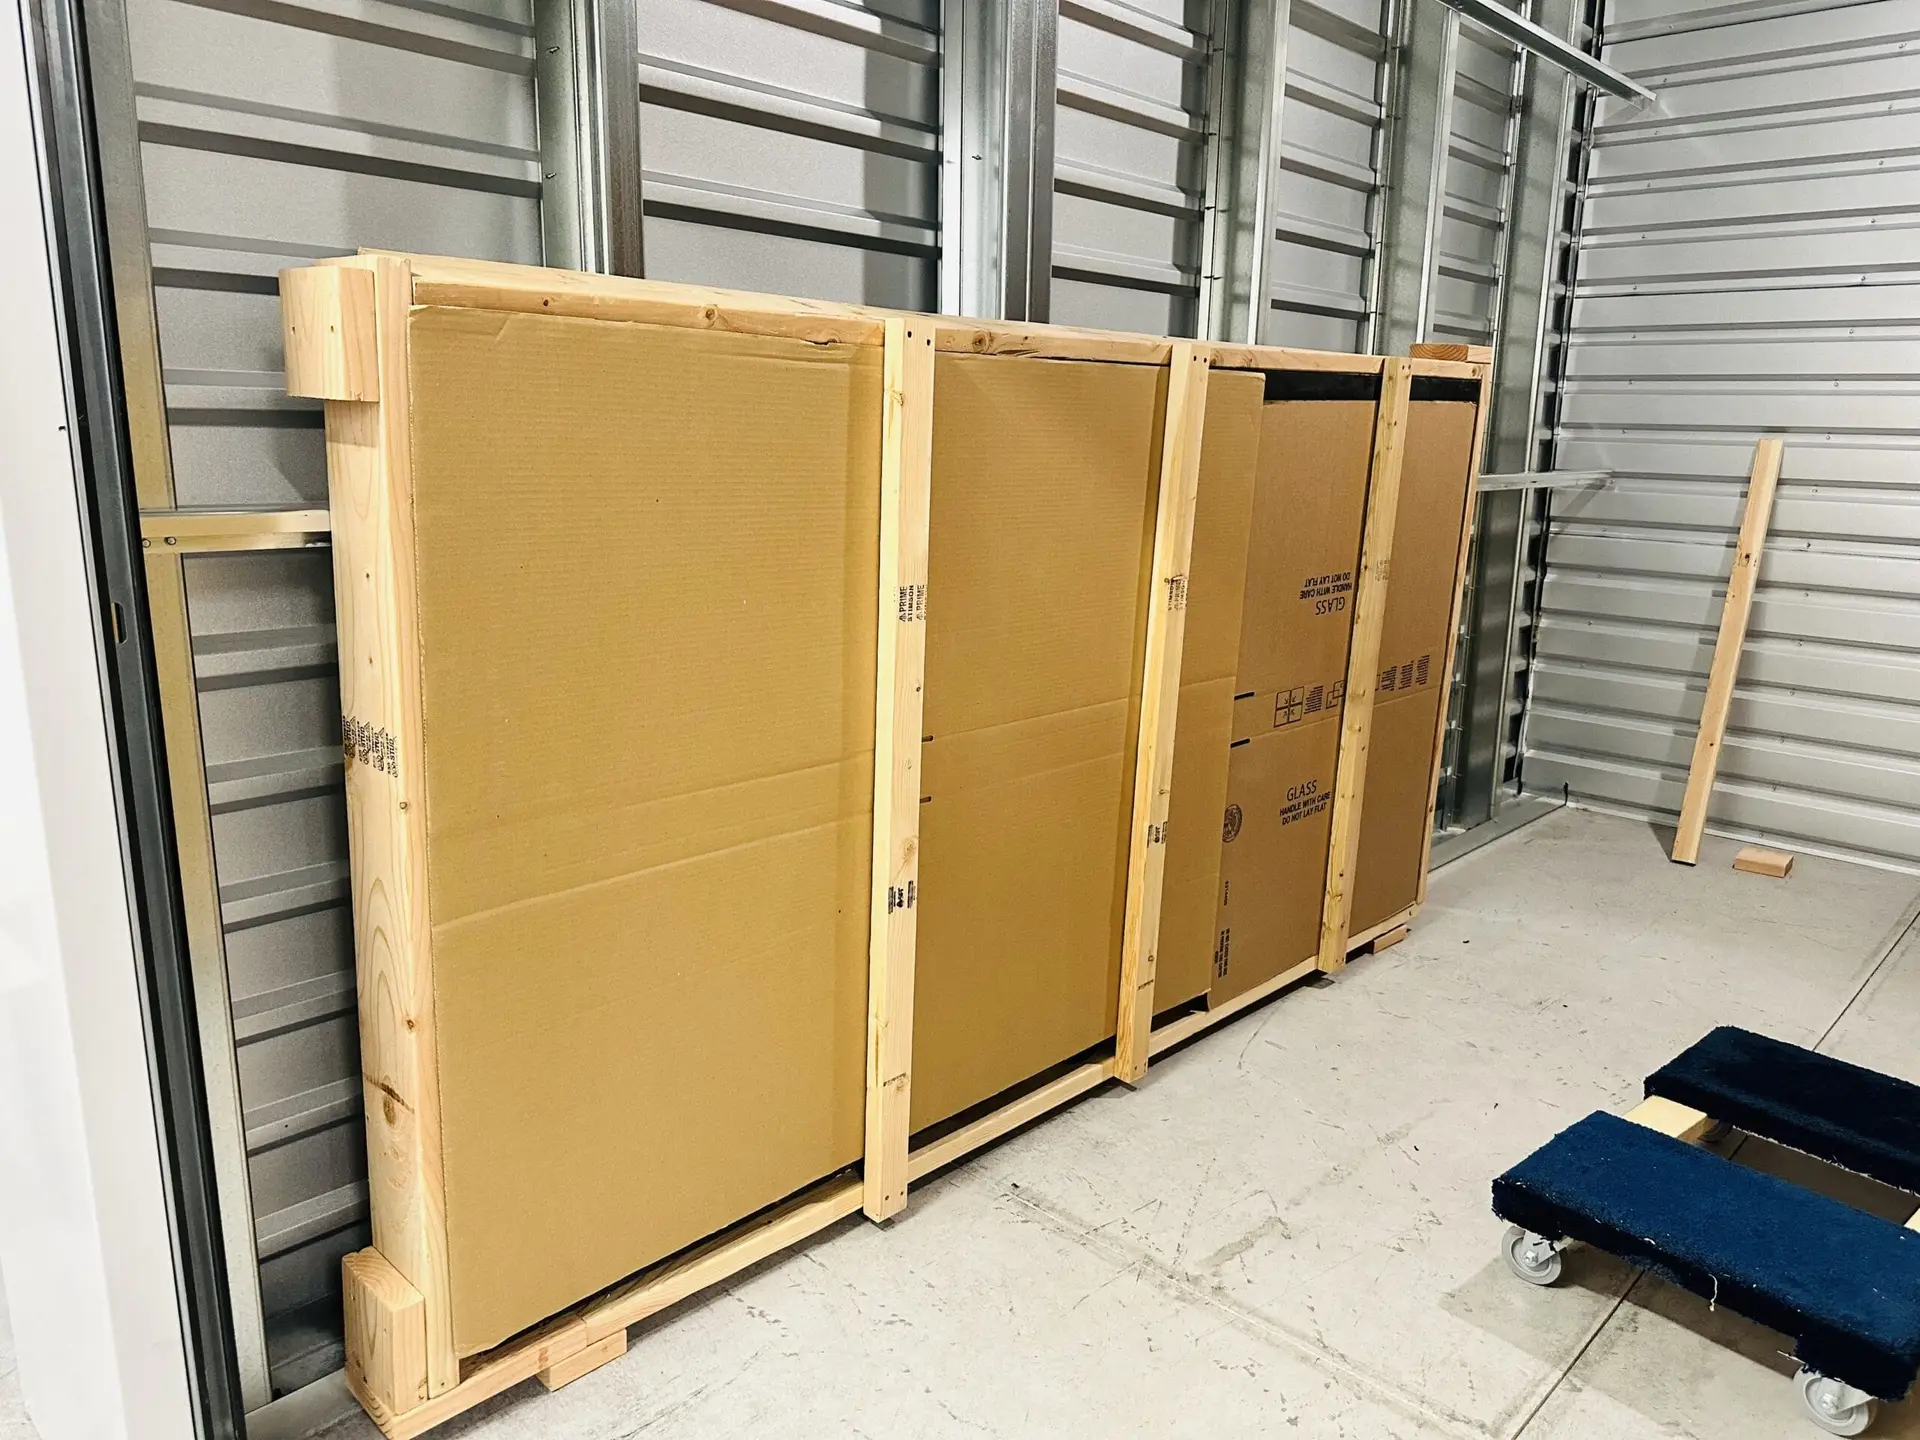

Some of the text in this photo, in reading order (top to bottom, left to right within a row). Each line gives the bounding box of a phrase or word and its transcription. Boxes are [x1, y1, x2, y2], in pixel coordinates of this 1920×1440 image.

[899, 586, 908, 612] PRIME
[916, 584, 924, 611] PRIME
[1299, 582, 1352, 600] HANDLE WITH CARE
[1315, 596, 1345, 616] GLASS
[1287, 780, 1317, 801] GLASS
[1280, 791, 1331, 816] HANDLE WITH CARE
[1282, 802, 1327, 825] DO NOT LAY FLAT
